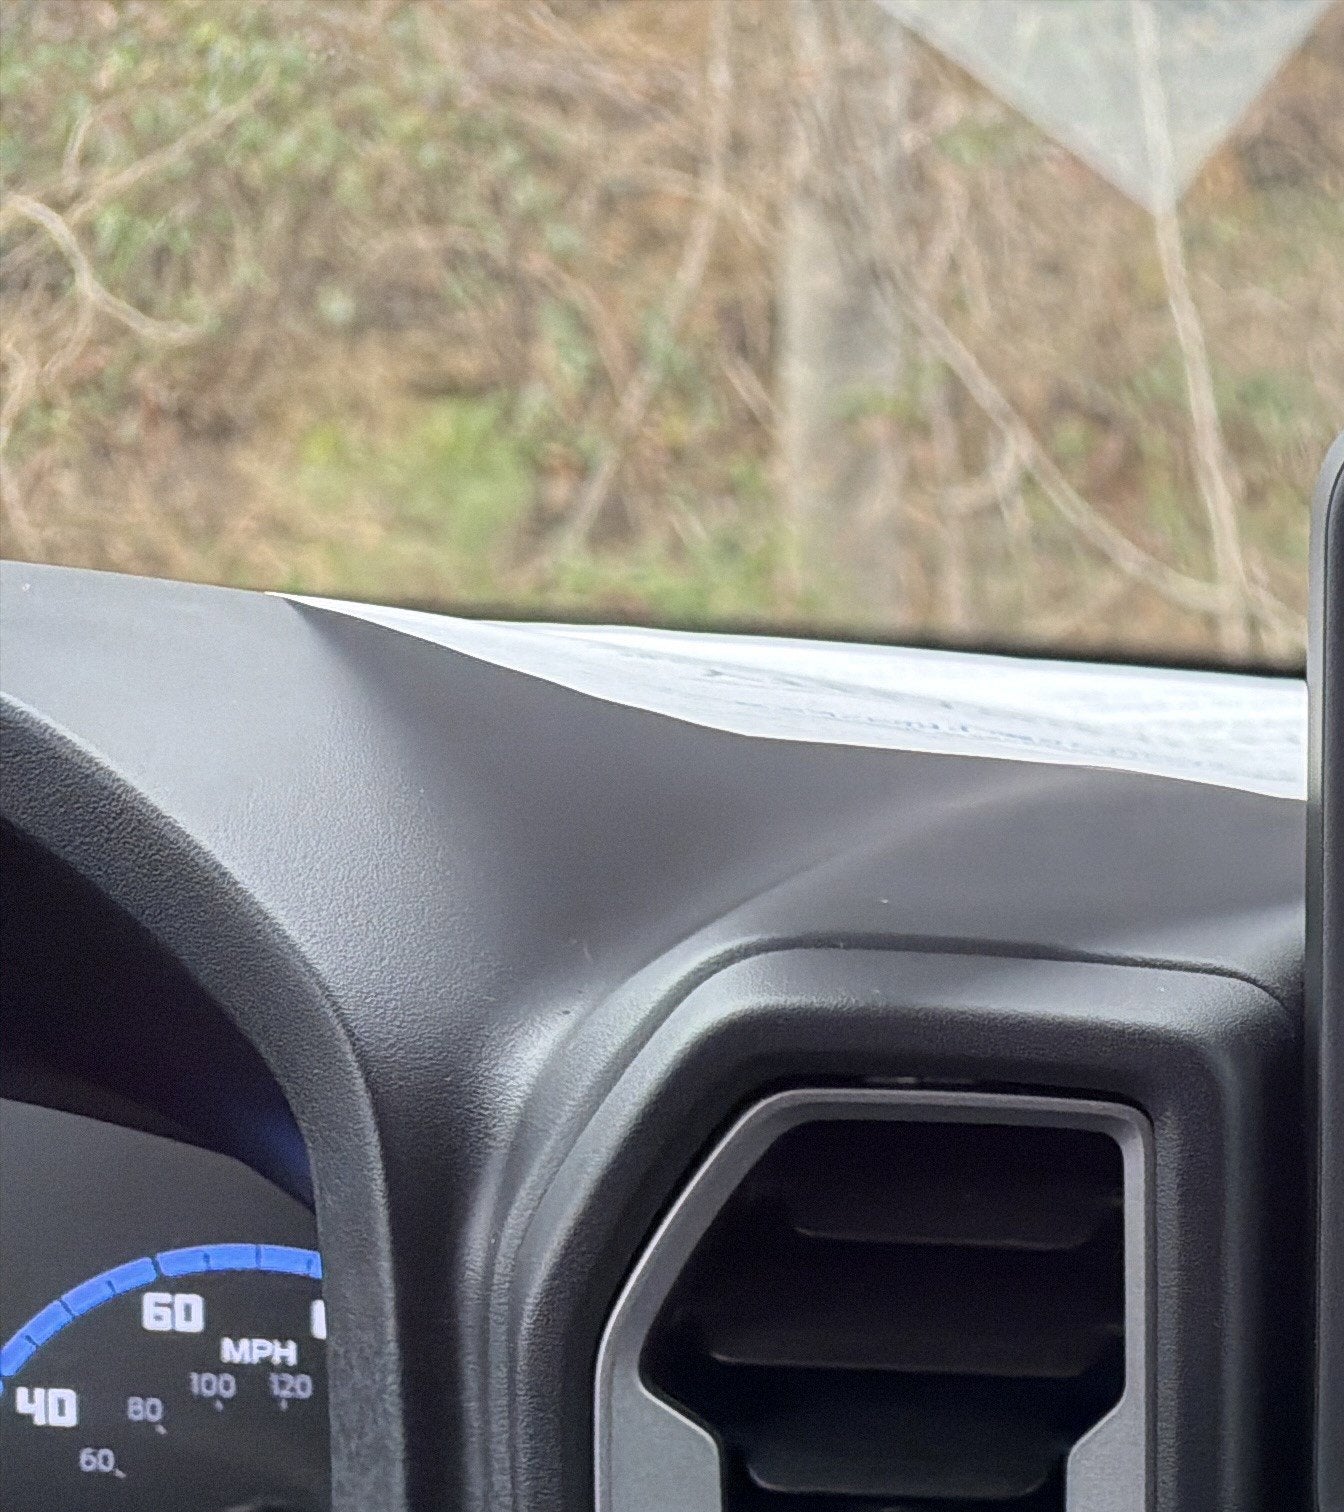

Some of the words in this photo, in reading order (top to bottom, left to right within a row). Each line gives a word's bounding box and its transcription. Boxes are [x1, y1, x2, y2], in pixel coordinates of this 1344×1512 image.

[141, 1292, 205, 1333] 60
[220, 1337, 297, 1366] MPH
[189, 1372, 236, 1399] 100
[269, 1373, 313, 1400] 120
[15, 1386, 79, 1428] 40
[127, 1396, 163, 1422] 80
[79, 1448, 114, 1472] 60
